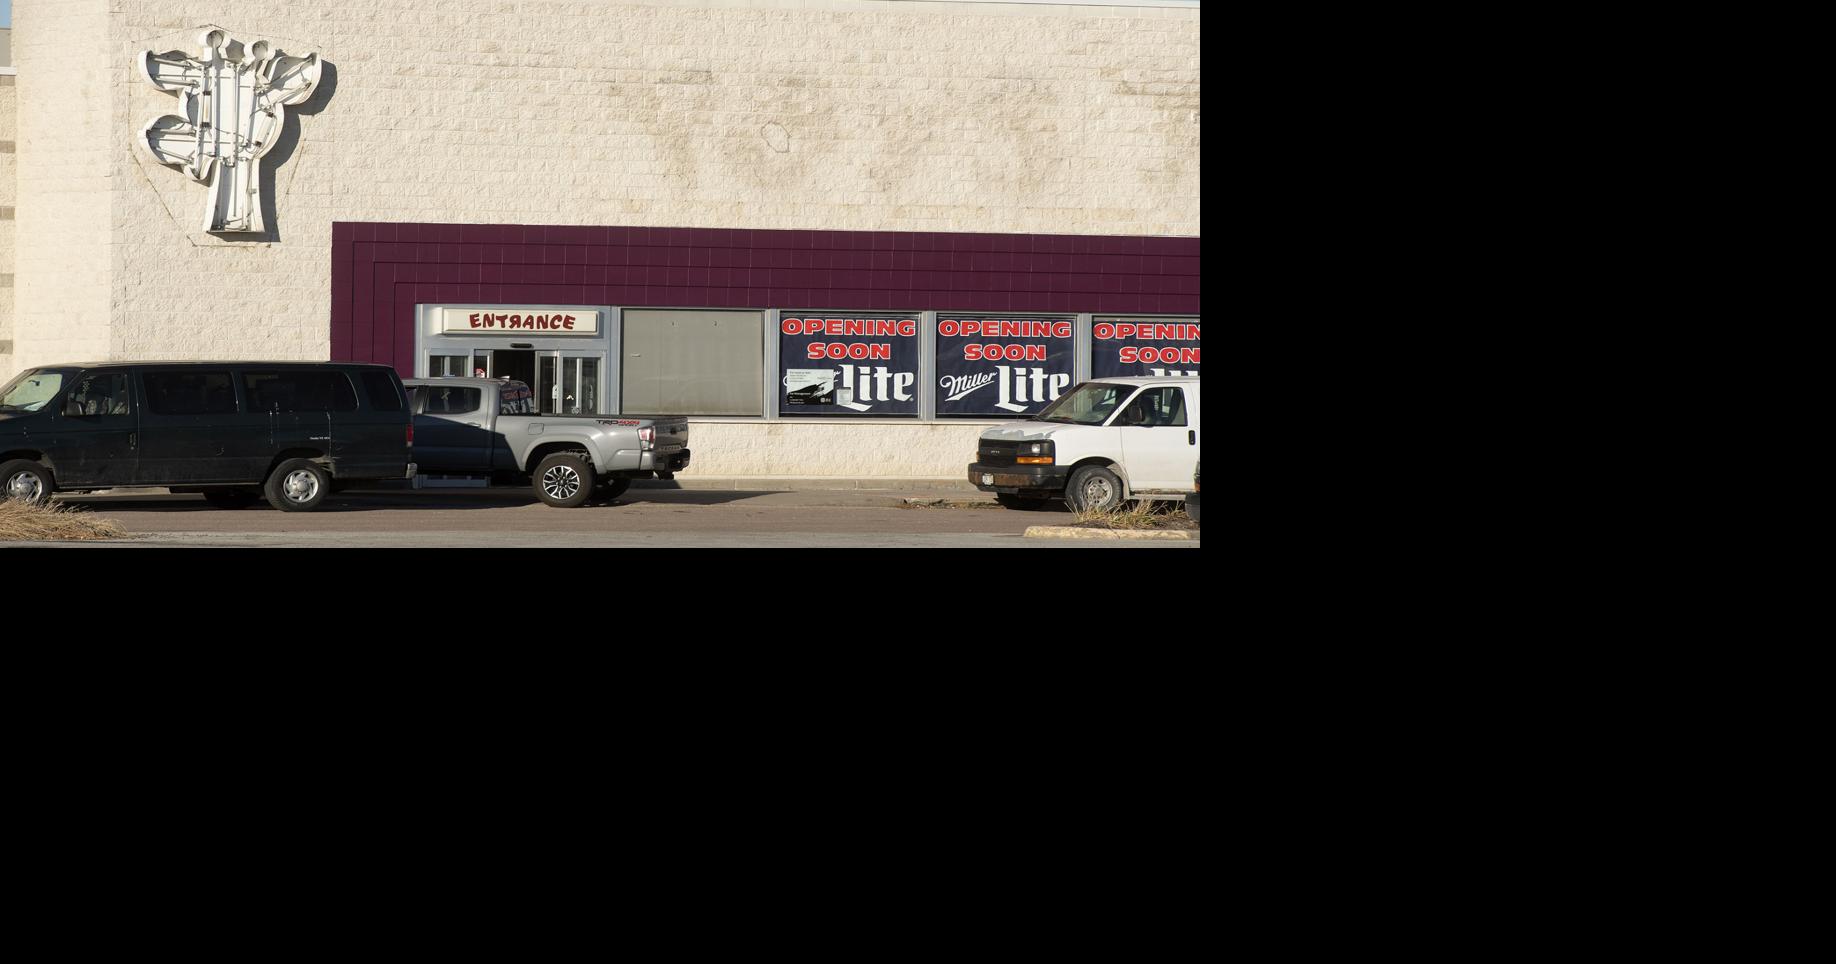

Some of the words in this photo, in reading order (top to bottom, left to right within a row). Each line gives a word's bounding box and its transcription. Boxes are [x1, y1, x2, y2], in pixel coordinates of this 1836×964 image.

[469, 313, 576, 330] ENTRANCE
[782, 318, 916, 337] OPENING
[938, 320, 1071, 338] OPENING
[807, 342, 891, 360] SOON
[963, 343, 1047, 361] SOON
[1119, 346, 1201, 364] SOON
[838, 364, 914, 412] Lite
[939, 372, 998, 401] Miller
[994, 365, 1070, 413] Lite
